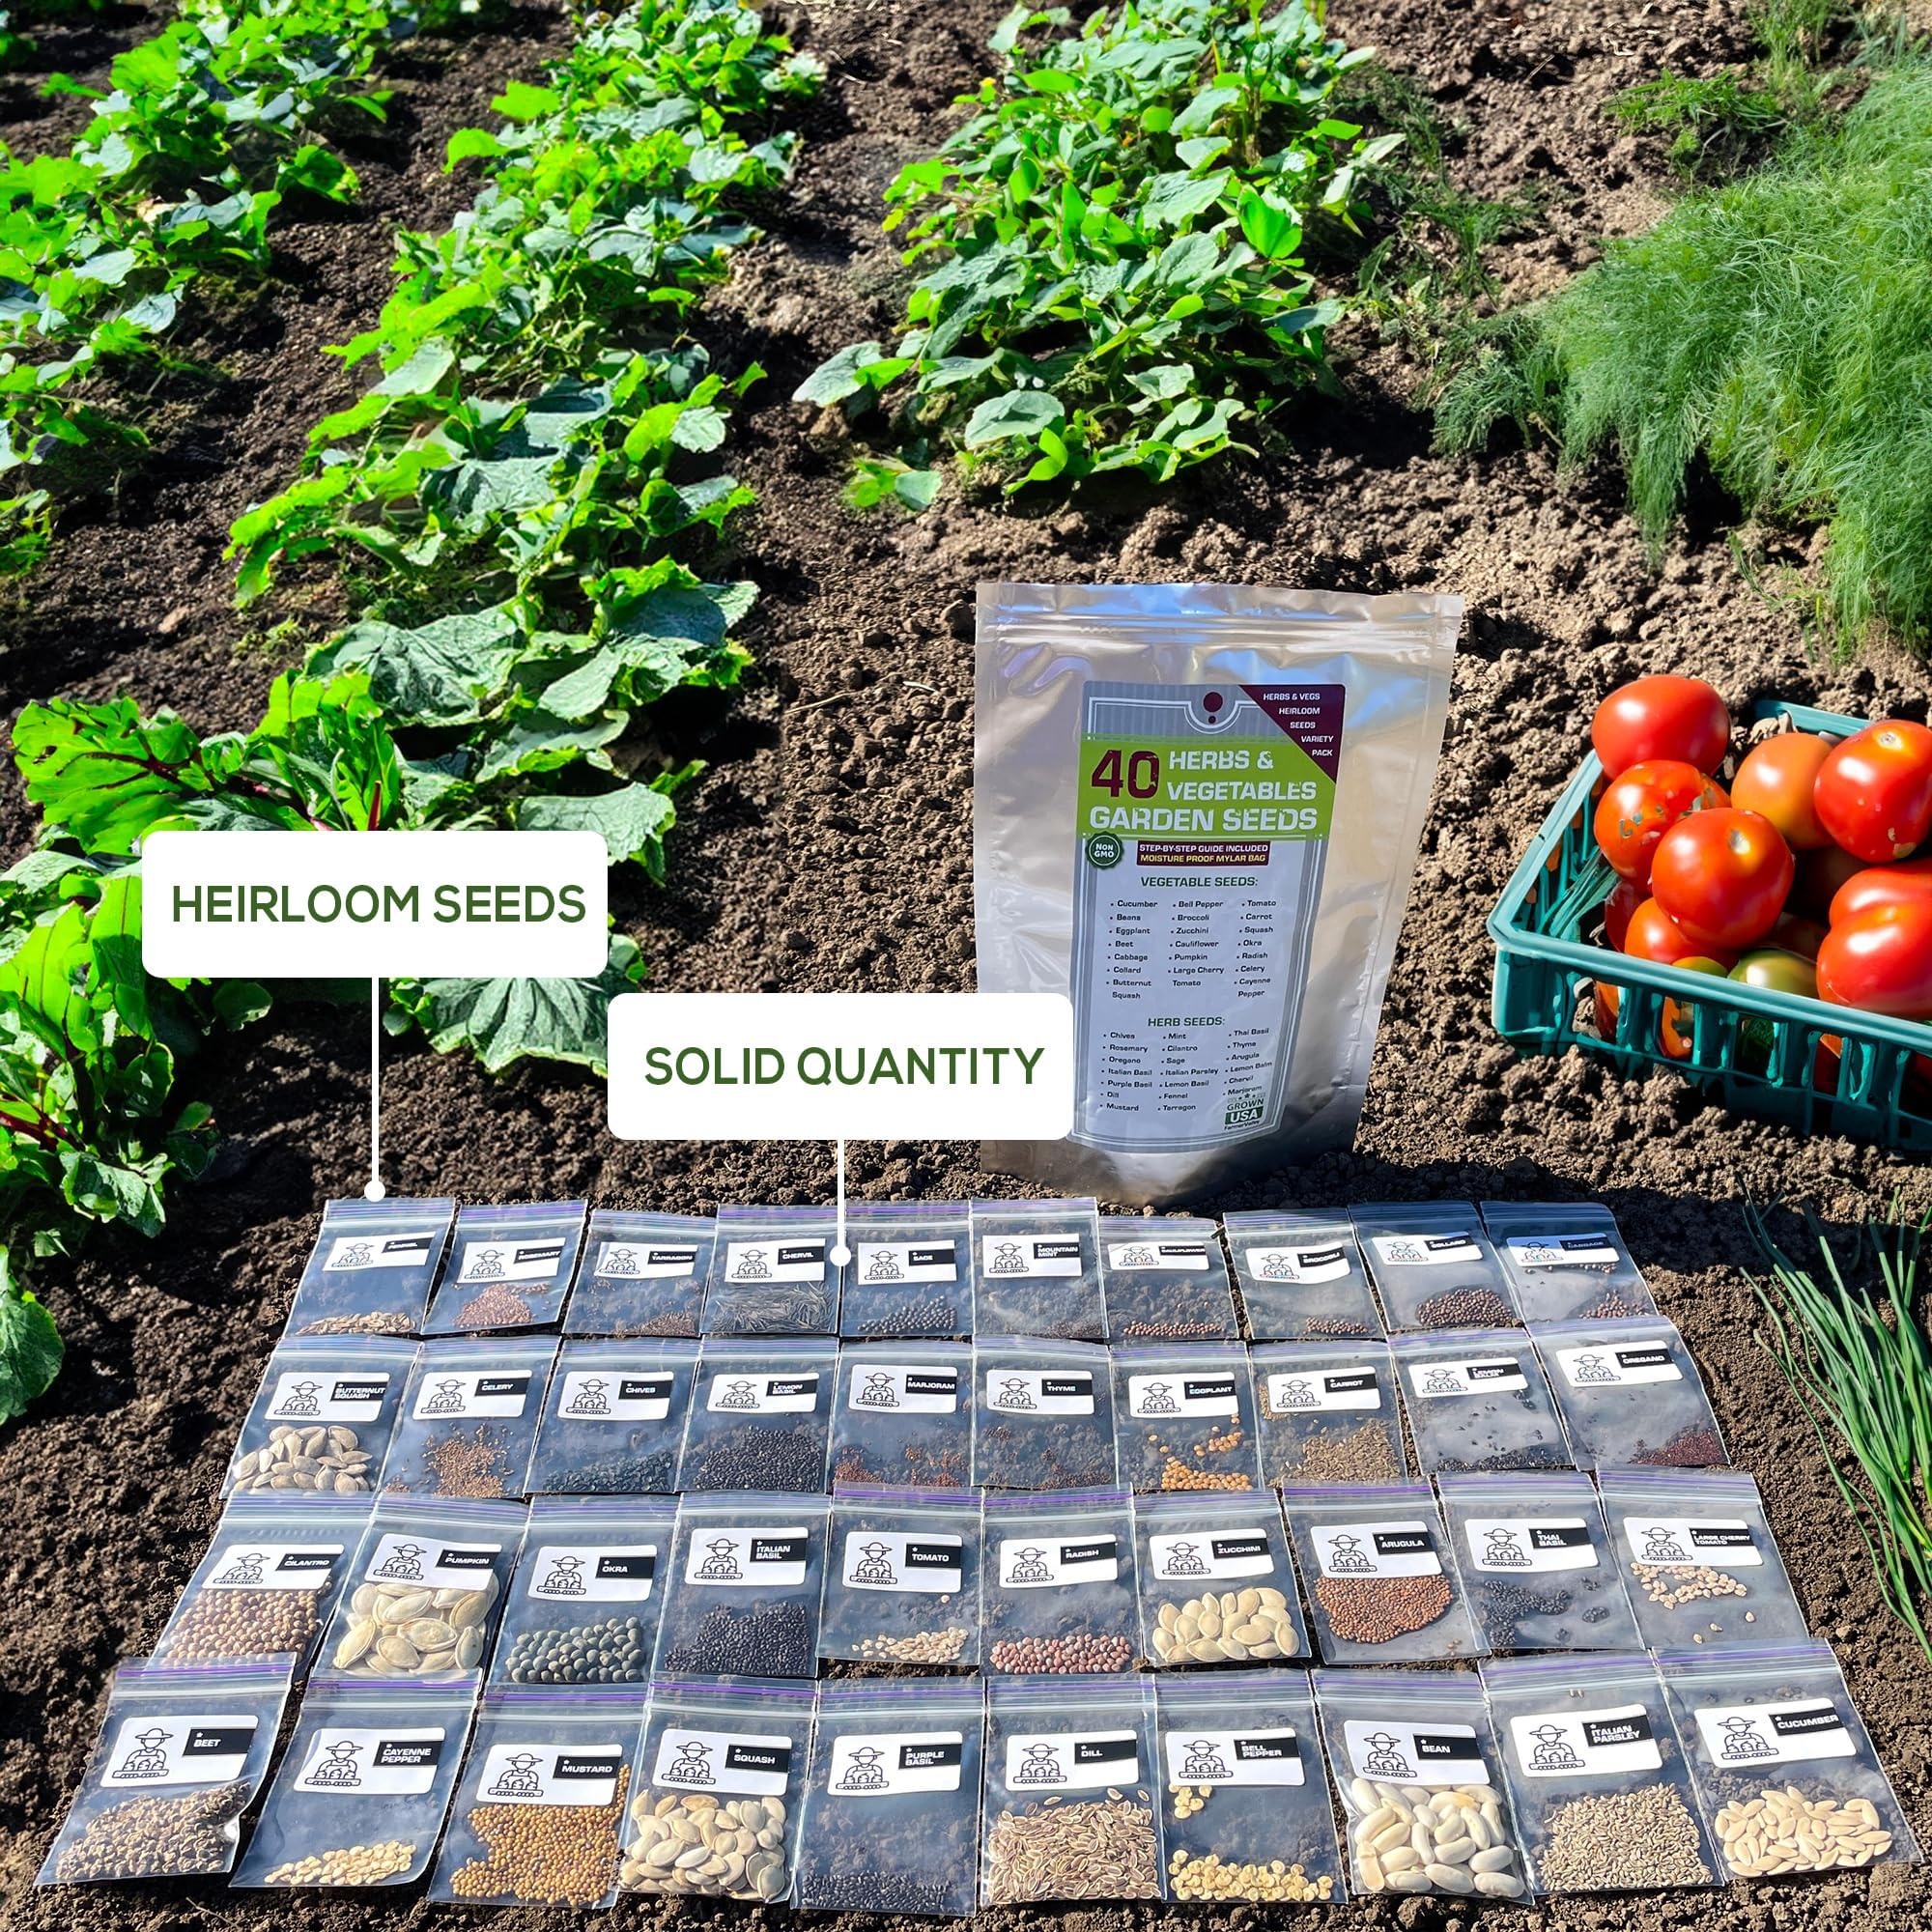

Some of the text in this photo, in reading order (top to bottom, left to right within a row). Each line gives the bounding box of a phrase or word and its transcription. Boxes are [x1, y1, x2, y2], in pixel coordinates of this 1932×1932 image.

[1263, 693, 1321, 701] HERBS & VEGS
[1300, 735, 1333, 744] VARIETY
[1312, 749, 1333, 757] PACK
[1169, 751, 1273, 770] HERBS &
[1091, 749, 1160, 799] 40
[1167, 781, 1317, 801] VEGETABLES
[1090, 806, 1318, 832] GARDEN SEEDS
[1139, 844, 1268, 853] STEP-BY-STEP GUIDE INCLUDED
[1140, 854, 1184, 863] MOISTURE
[1248, 854, 1266, 863] BAG
[1141, 876, 1258, 887] VEGETABLE SEEDS:
[1194, 900, 1224, 910] Pepper
[1115, 926, 1151, 936] Eggplant
[1244, 926, 1274, 935] Squash
[1114, 953, 1148, 962] Cabbage
[1174, 953, 1208, 962] Pumpkin
[1173, 966, 1225, 976] Large Cherry
[1238, 978, 1271, 987] Cayenne
[1112, 991, 1141, 1000] Squash
[1237, 990, 1264, 999] Pepper
[1148, 1017, 1225, 1027] HERB SEEDS:
[1109, 1044, 1149, 1053] Rosemary
[1166, 1057, 1185, 1065] Sage
[1231, 1052, 1260, 1062] Arugula
[1255, 1061, 1273, 1069] Balm
[1190, 1067, 1219, 1077] Parsley
[1229, 1075, 1254, 1084] Chervil
[1107, 1080, 1132, 1089] Purple
[1227, 1085, 1263, 1095] Marjoram
[1106, 1103, 1139, 1112] Mustard
[1162, 1104, 1197, 1113] Tarragon
[1227, 1098, 1264, 1111] GROWN
[1231, 1109, 1258, 1122] USA
[1623, 1354, 1665, 1365] OREGANO
[1329, 1379, 1363, 1388] CARROT
[1189, 1386, 1234, 1395] EGGPLANT
[1381, 1540, 1425, 1548] ARUGULA
[756, 1545, 791, 1553] ITALIAN
[1217, 1546, 1262, 1554] ZUCCHINI
[912, 1553, 950, 1562] TOMATO
[1065, 1549, 1099, 1559] RADISH
[444, 1555, 490, 1565] PUMPKIN
[1776, 1715, 1839, 1729] CUCUMBER
[1591, 1725, 1633, 1737] ITALIAN
[1593, 1731, 1641, 1745] PARSLEY
[193, 1739, 221, 1747] BEET
[383, 1747, 432, 1756] CAYENNE
[1422, 1745, 1451, 1754] BEAN
[906, 1750, 945, 1759] PURPLE
[381, 1755, 422, 1764] PEPPER
[734, 1754, 776, 1765] SQUASH
[561, 1764, 613, 1774] MUSTARD
